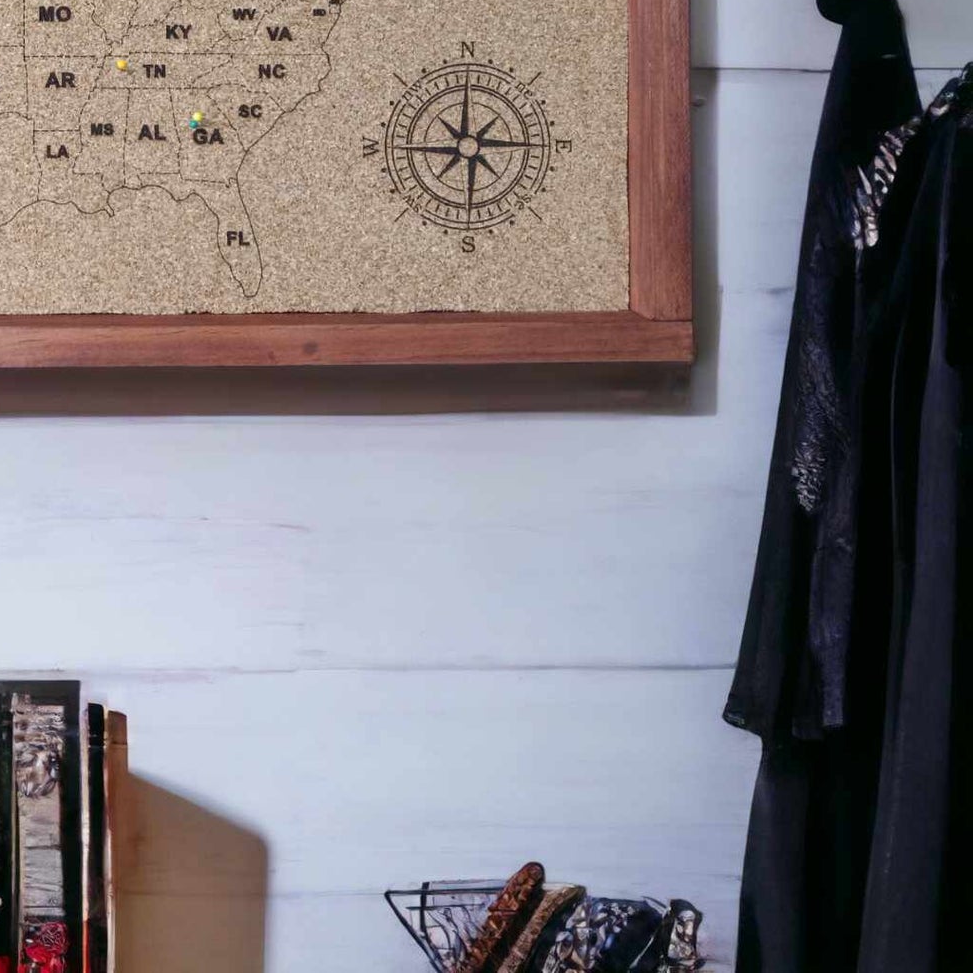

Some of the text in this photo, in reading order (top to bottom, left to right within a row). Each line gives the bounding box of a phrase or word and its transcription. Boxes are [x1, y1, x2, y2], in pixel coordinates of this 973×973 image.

[38, 6, 72, 22] MO
[232, 8, 256, 21] WV
[166, 24, 192, 39] KY
[266, 26, 293, 42] VA
[461, 41, 475, 58] N
[142, 64, 166, 78] TN
[258, 64, 285, 79] NC
[45, 72, 76, 89] AR
[238, 104, 262, 119] SC
[90, 123, 114, 136] MS
[138, 124, 166, 141] AL
[192, 128, 224, 145] GA
[46, 145, 69, 159] LA
[362, 137, 379, 157] W
[555, 139, 572, 154] E
[226, 231, 250, 246] FL
[461, 236, 476, 253] S
